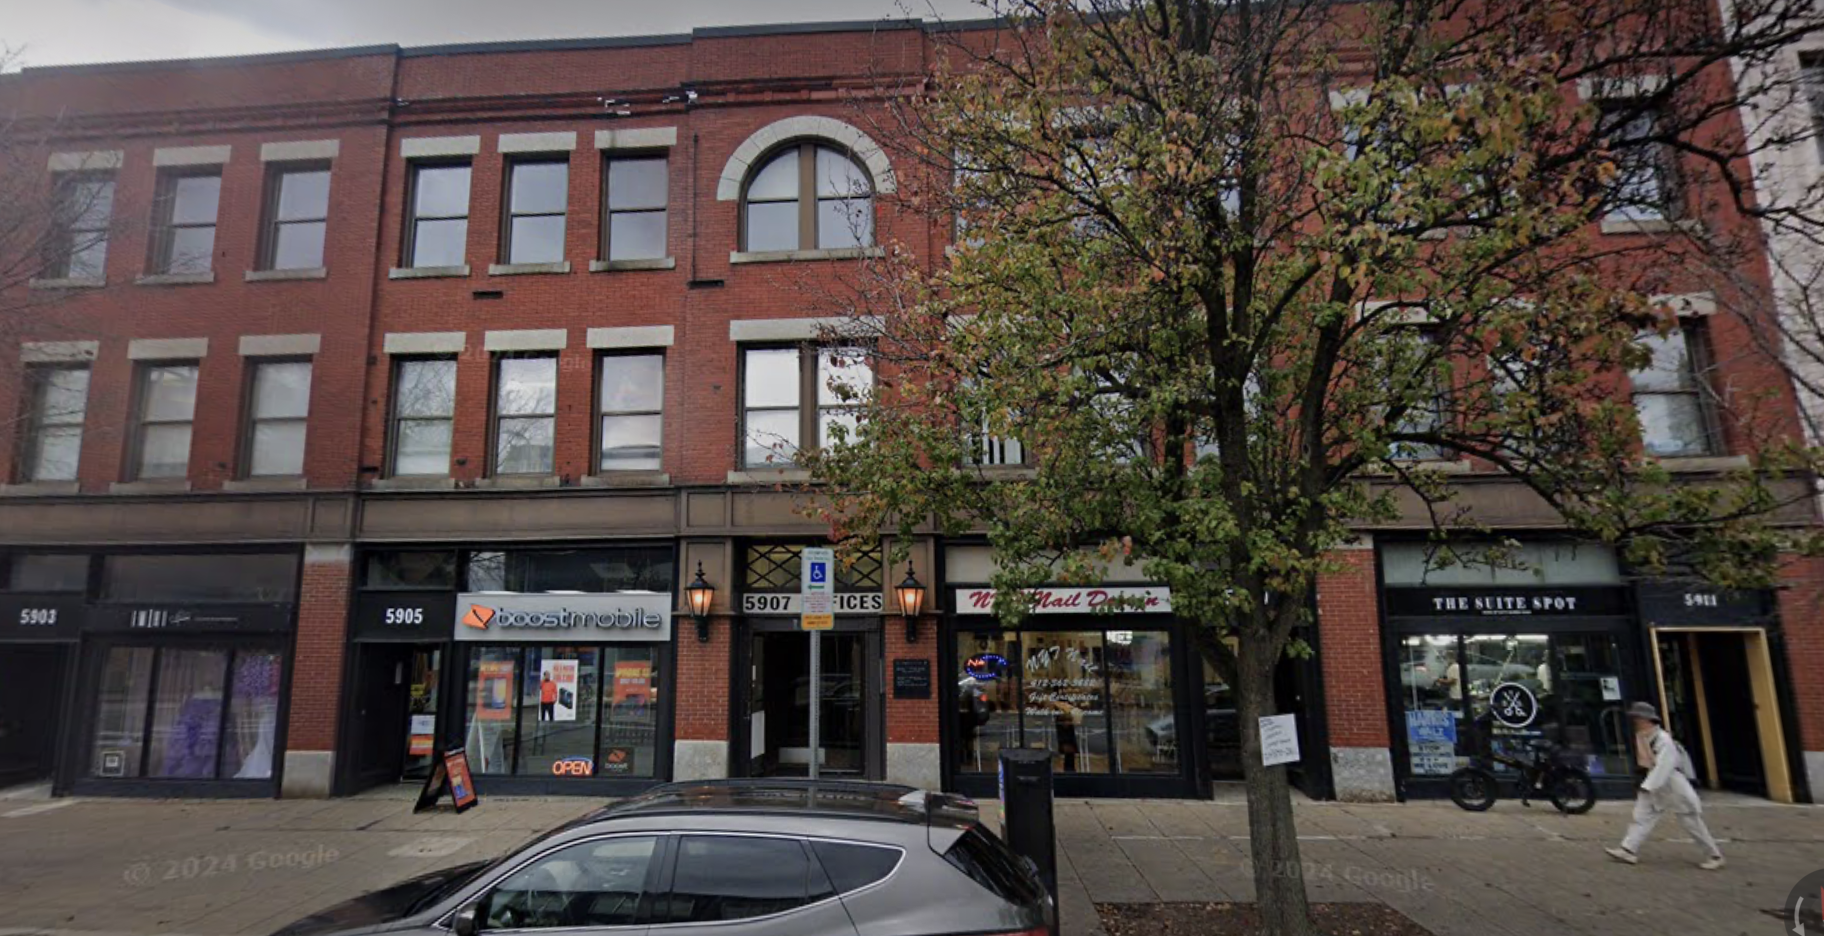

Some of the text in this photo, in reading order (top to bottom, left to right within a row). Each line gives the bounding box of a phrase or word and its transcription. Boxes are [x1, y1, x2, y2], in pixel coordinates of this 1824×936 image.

[745, 595, 791, 610] 5907
[1433, 597, 1576, 610] THE SUITE SPOT
[20, 609, 57, 624] 5903
[386, 608, 423, 623] 5905
[552, 760, 592, 776] OPEN
